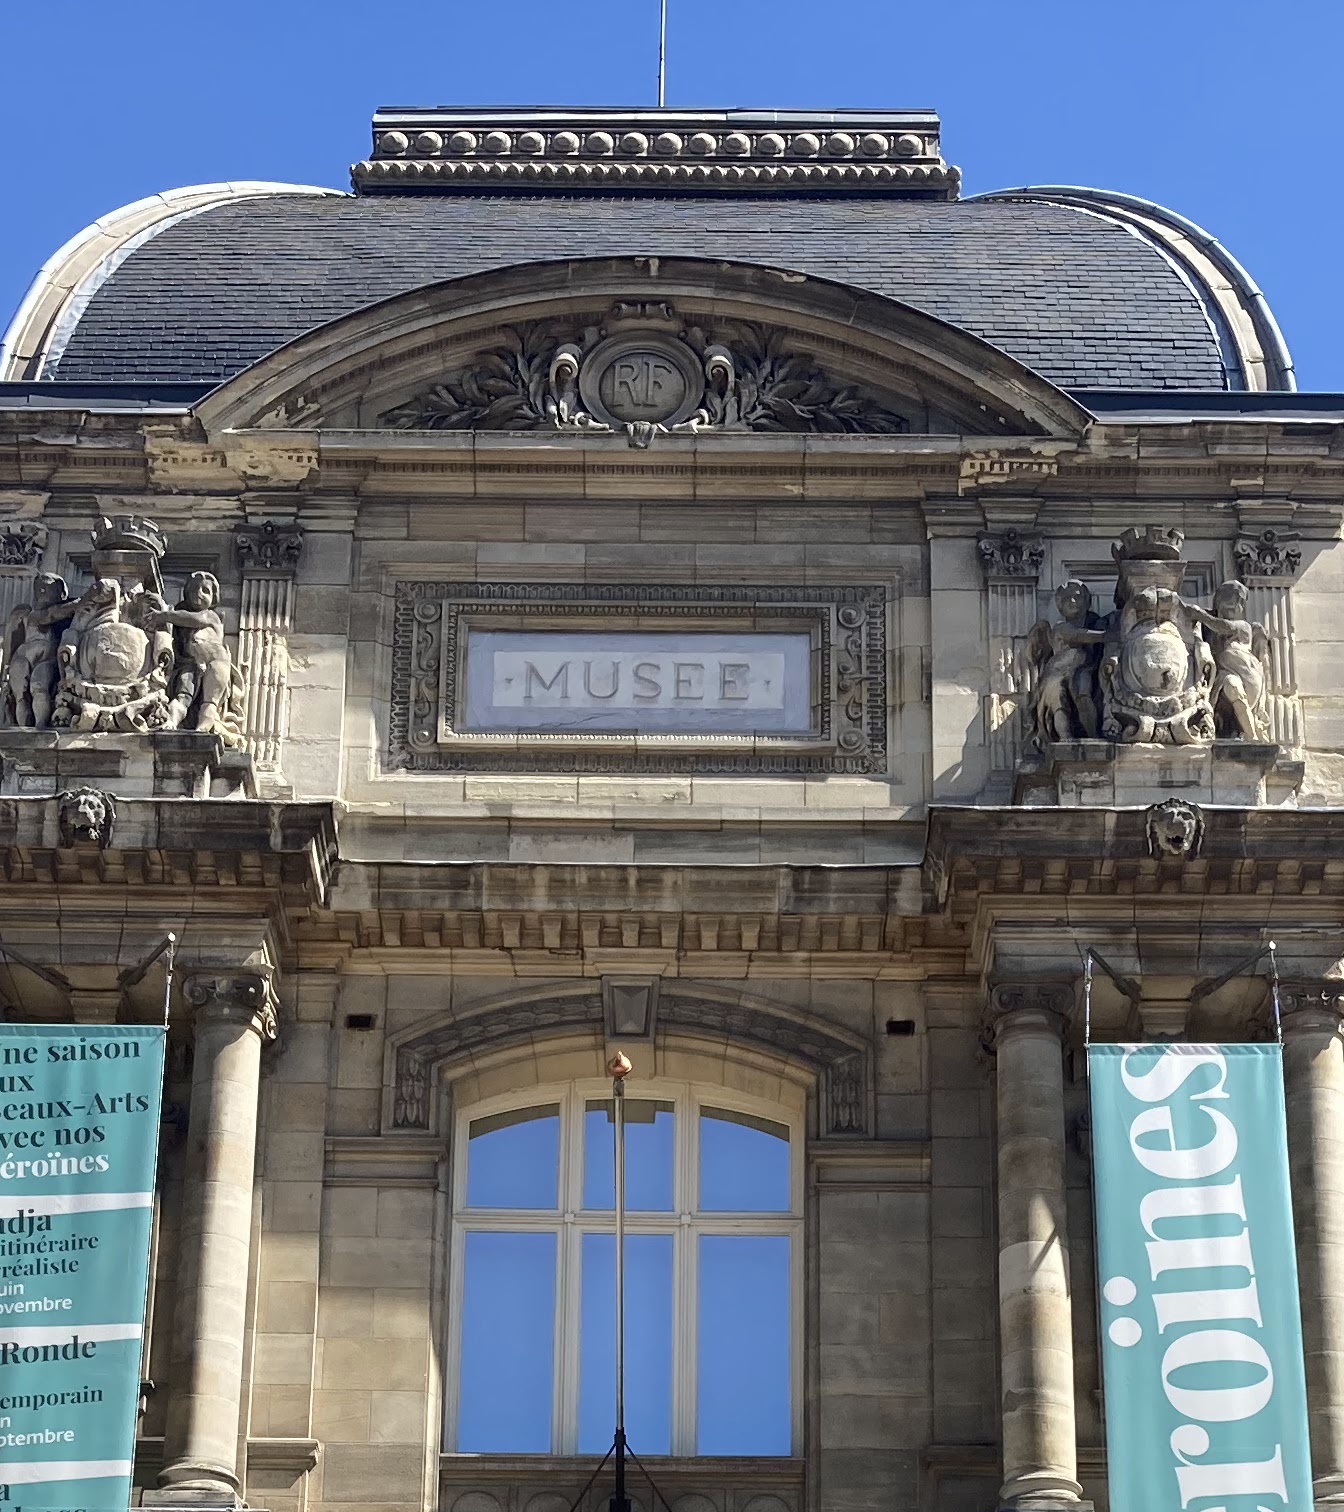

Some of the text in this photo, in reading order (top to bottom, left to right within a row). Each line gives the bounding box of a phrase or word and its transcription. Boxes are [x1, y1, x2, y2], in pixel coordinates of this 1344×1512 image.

[608, 361, 673, 408] RF
[522, 660, 750, 702] MUSEE
[46, 1037, 140, 1063] saison
[54, 1124, 106, 1146] nos
[0, 1233, 99, 1257] itinéraire
[0, 1335, 97, 1366] Ronde
